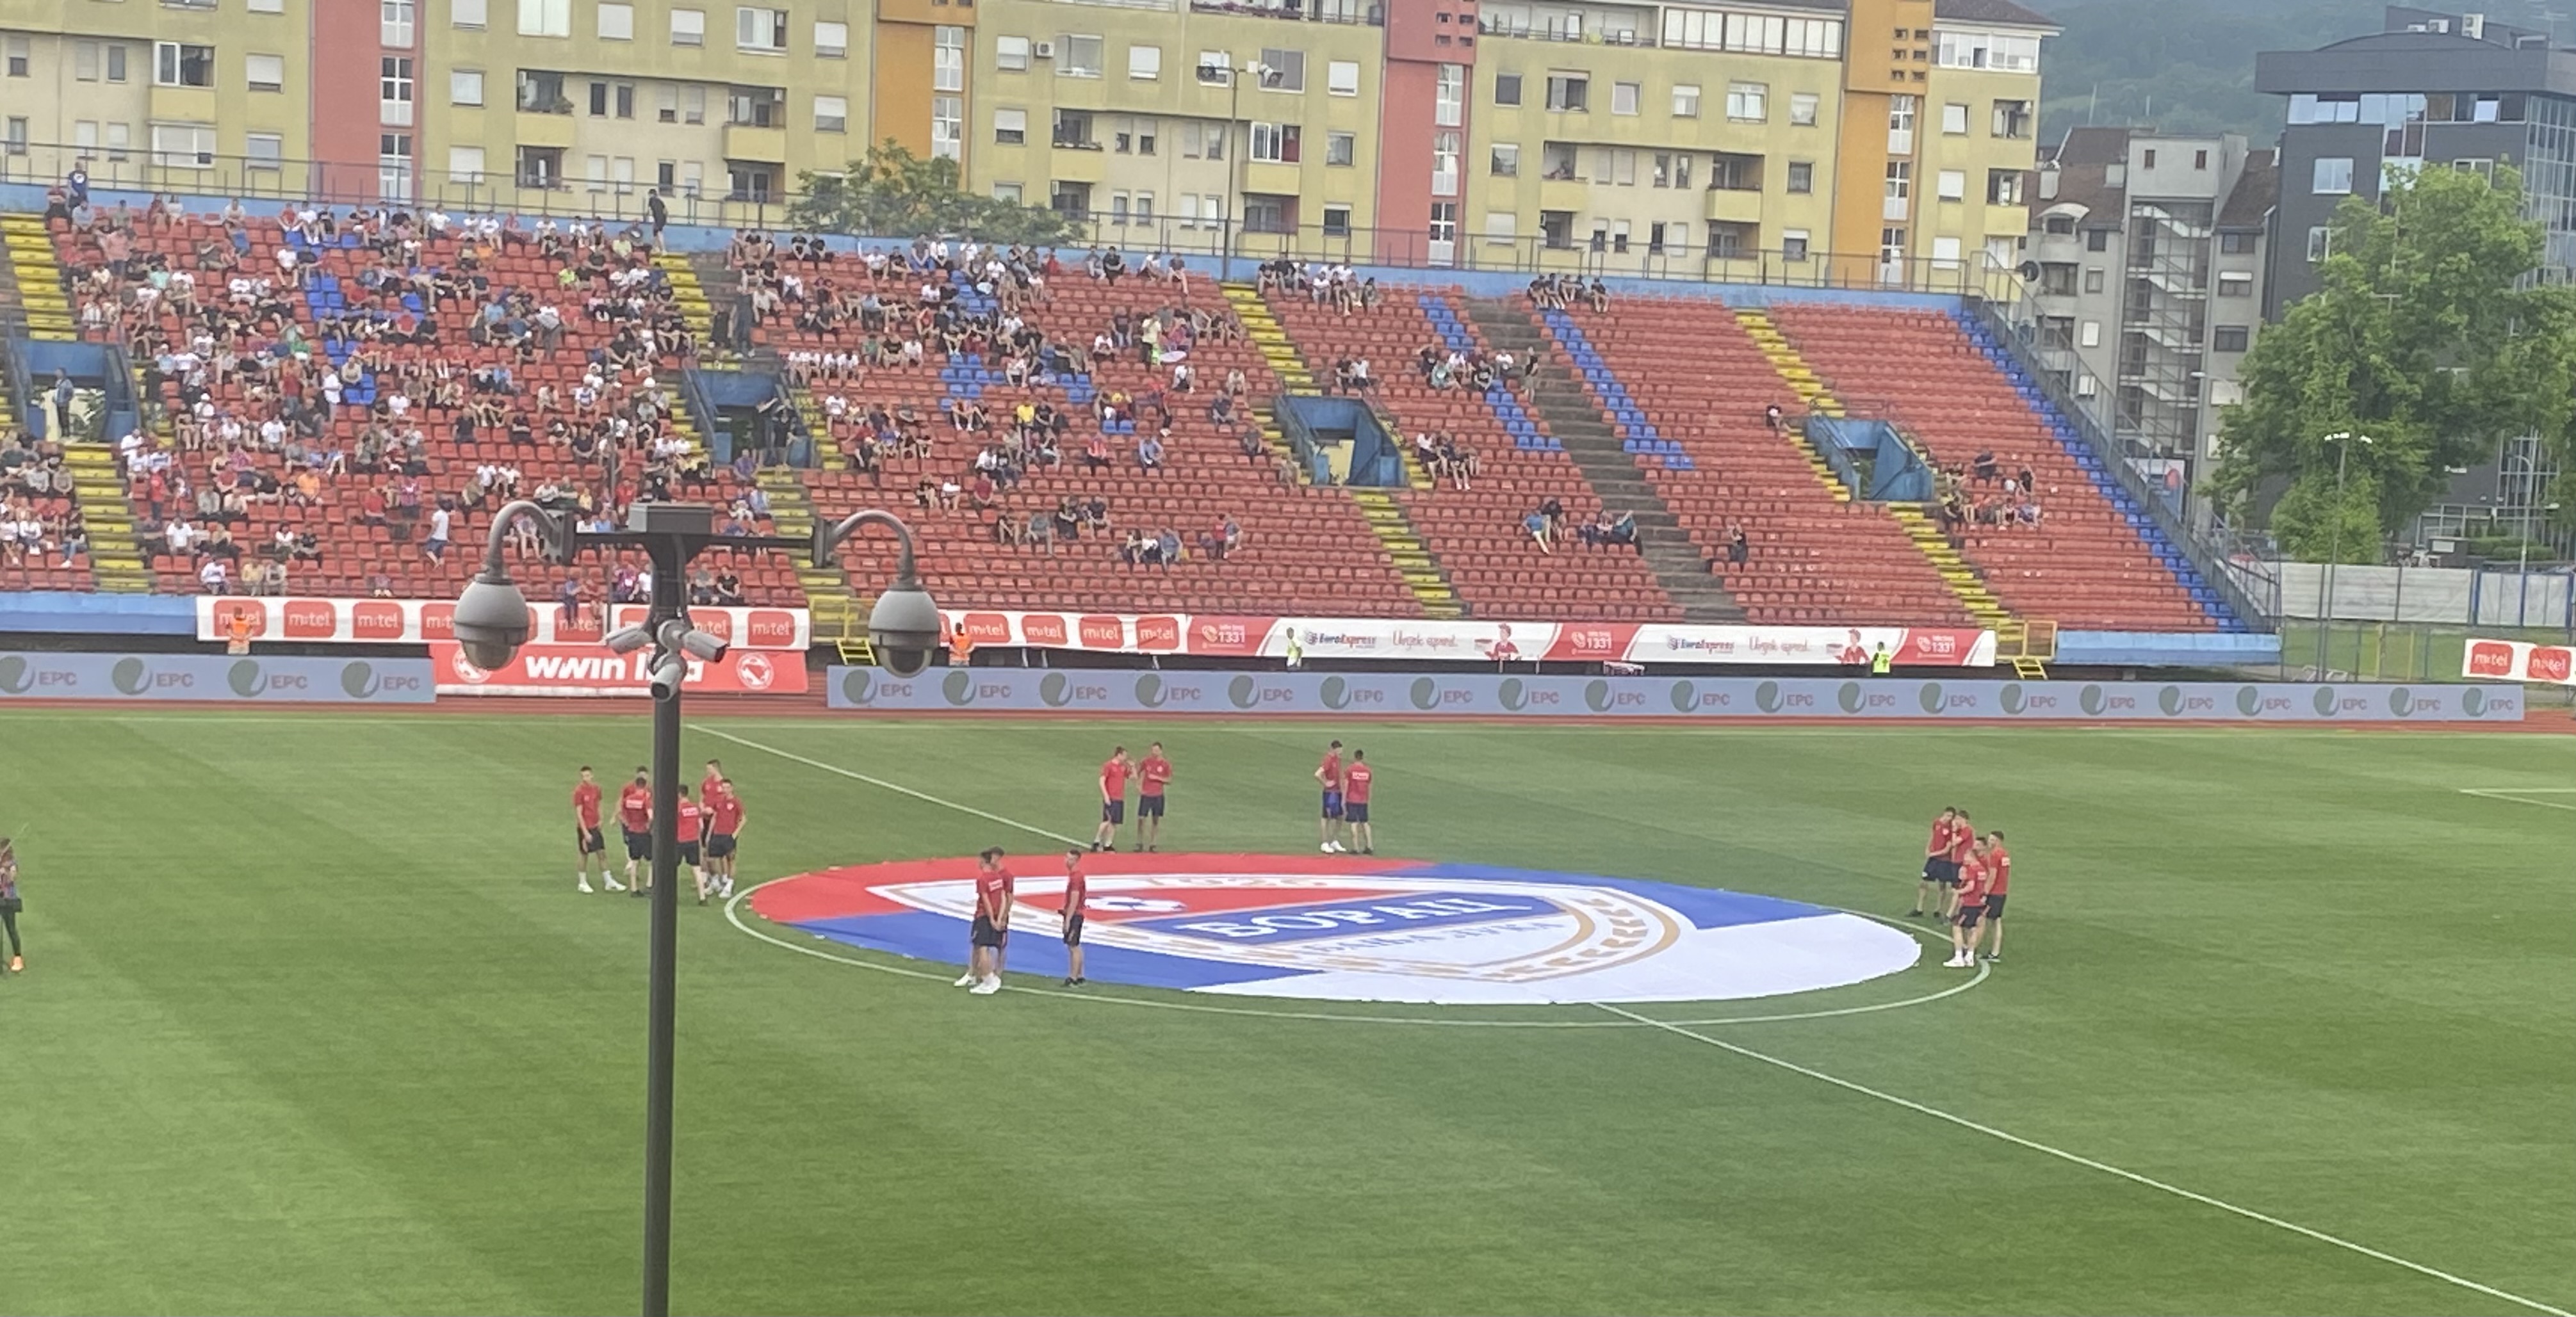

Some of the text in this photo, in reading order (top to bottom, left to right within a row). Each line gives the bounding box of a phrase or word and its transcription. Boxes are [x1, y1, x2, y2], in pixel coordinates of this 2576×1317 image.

[38, 672, 76, 686] EPC
[156, 673, 193, 688] EPC
[272, 675, 307, 690] EPC
[384, 676, 420, 691] EPC
[881, 683, 912, 698] EPC
[979, 684, 1011, 699] EPC
[1076, 686, 1107, 700] EPC
[1171, 687, 1200, 701] EPC
[1263, 688, 1292, 702] EPC
[1354, 689, 1383, 702] EPC
[1444, 690, 1472, 704] EPC
[1531, 691, 1559, 704] EPC
[1617, 692, 1645, 706] EPC
[1702, 693, 1729, 706] EPC
[1786, 693, 1813, 706] EPC
[1869, 694, 1895, 707] EPC
[1950, 695, 1976, 707] EPC
[2030, 695, 2057, 708] EPC
[2109, 697, 2135, 709] EPC
[2187, 697, 2213, 709] EPC
[2265, 698, 2291, 710] EPC
[2342, 698, 2367, 710] EPC
[2417, 699, 2441, 711] EPC
[2489, 699, 2513, 711] EPC
